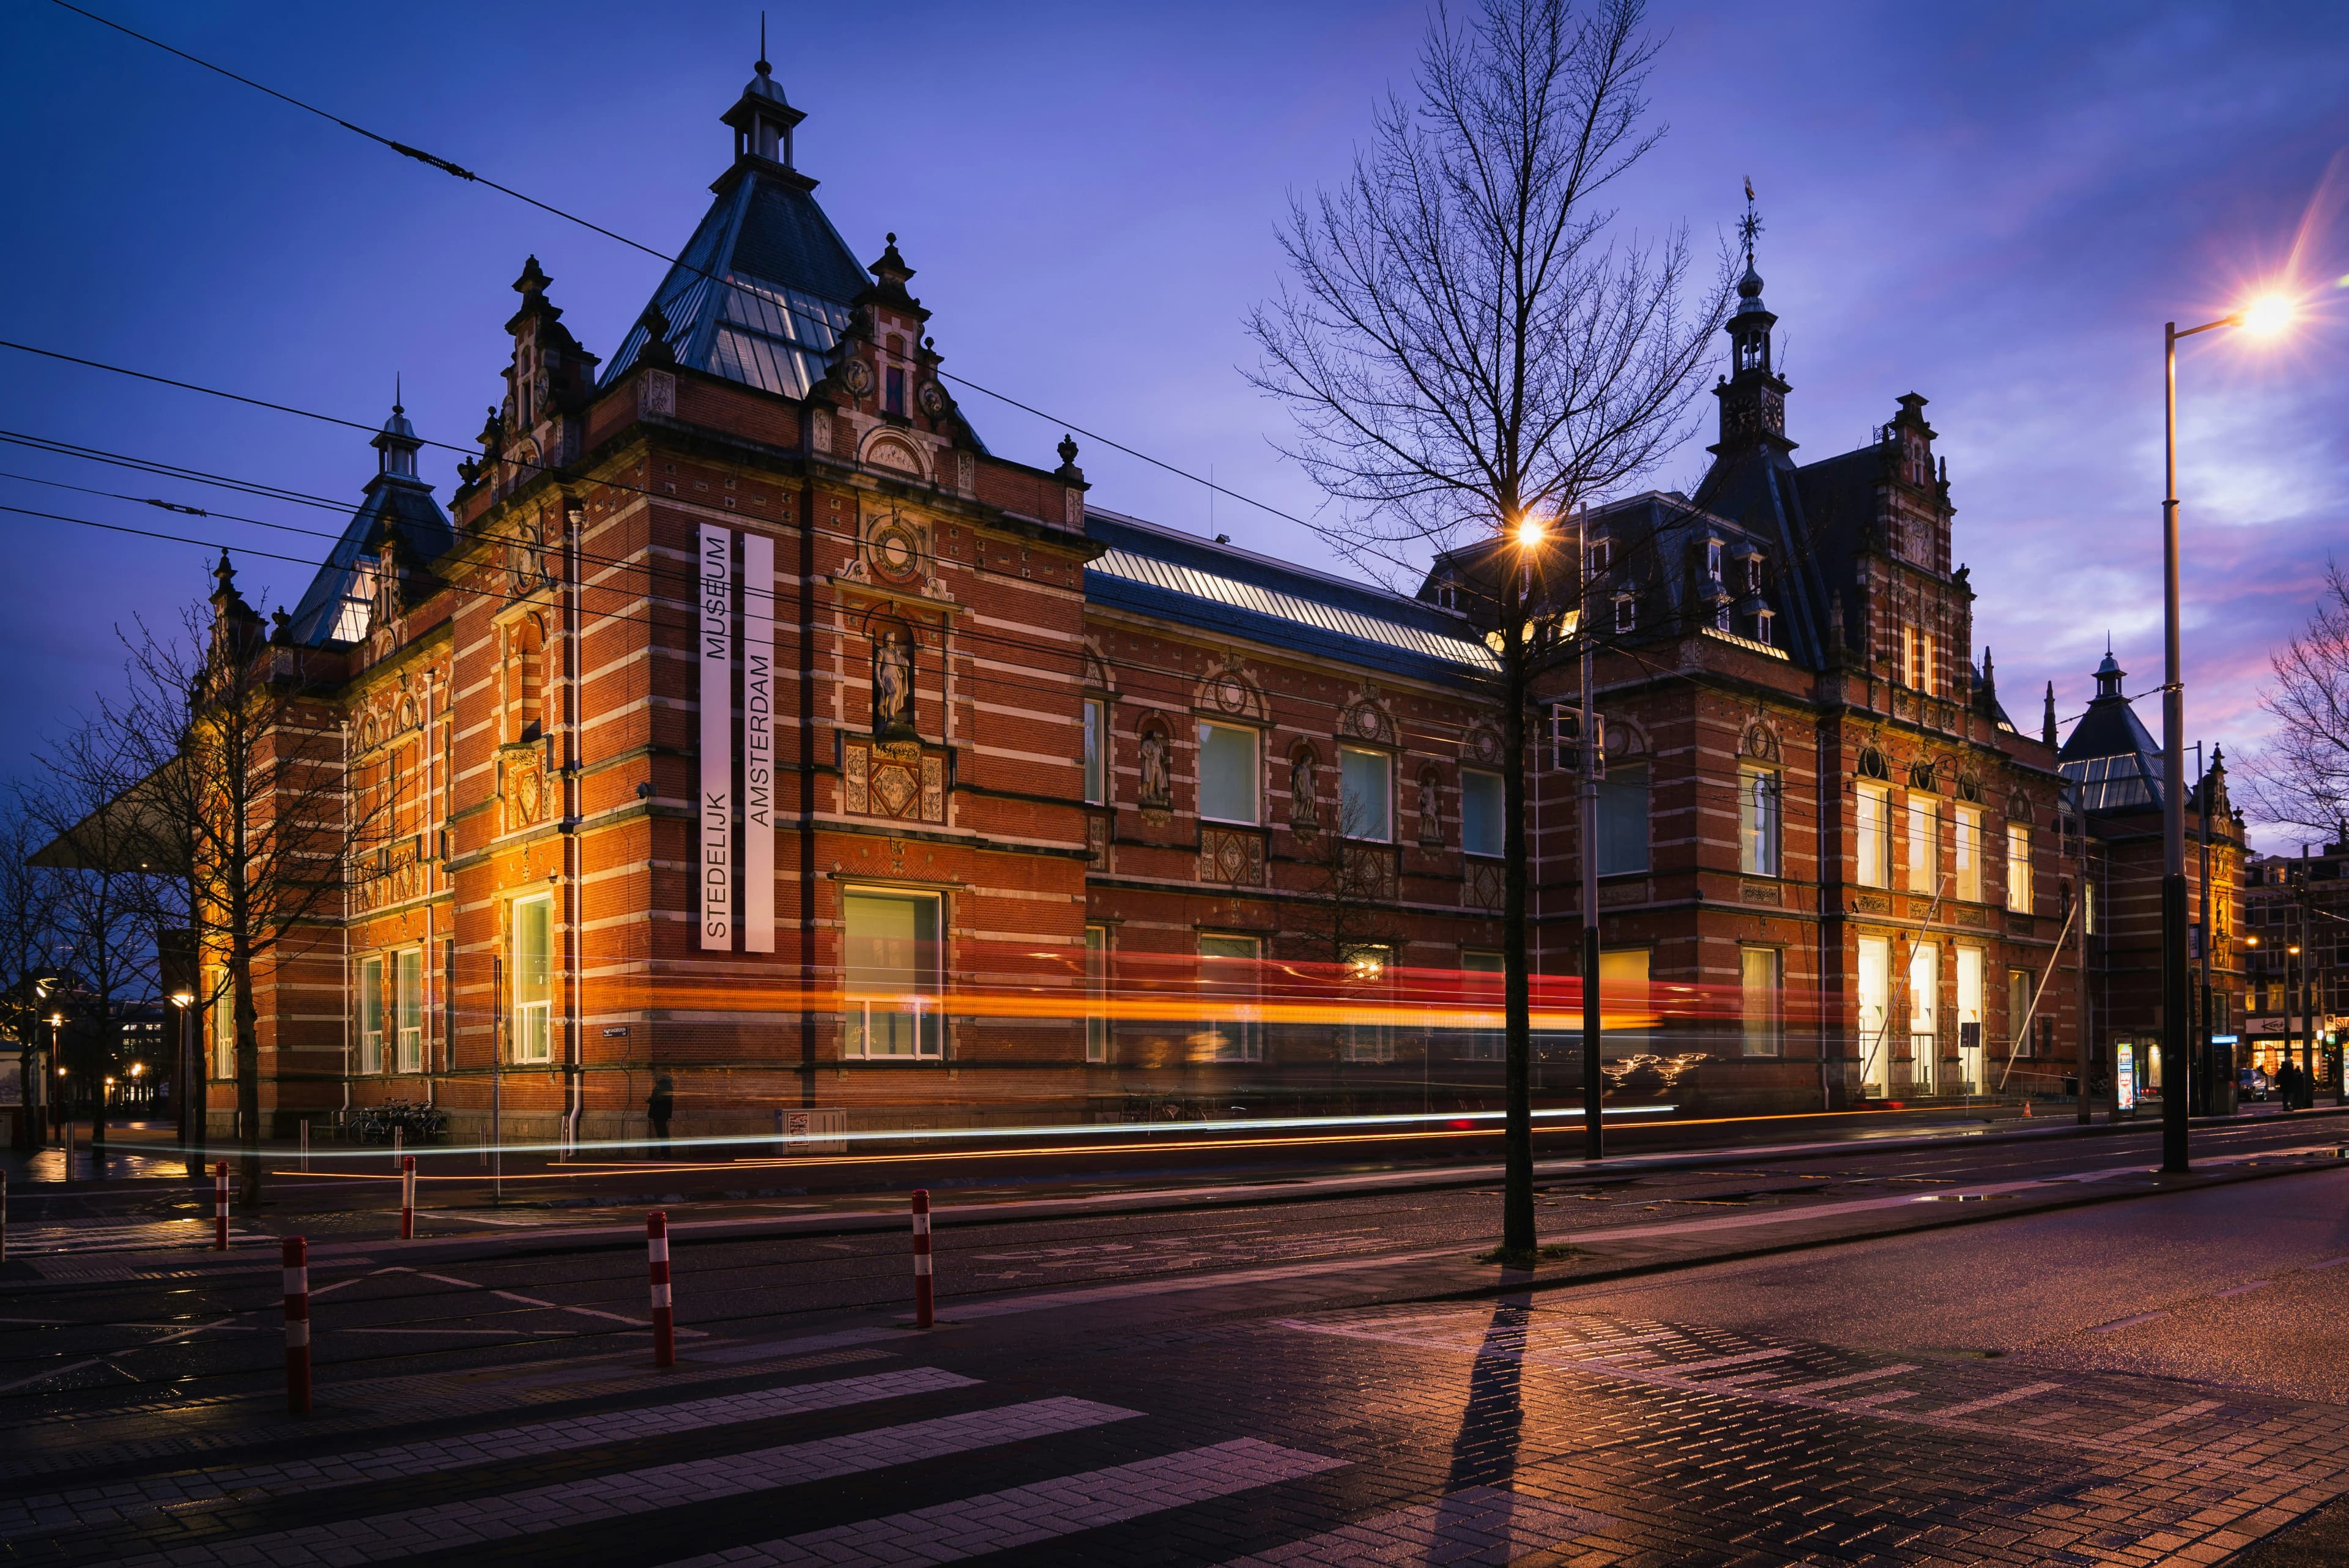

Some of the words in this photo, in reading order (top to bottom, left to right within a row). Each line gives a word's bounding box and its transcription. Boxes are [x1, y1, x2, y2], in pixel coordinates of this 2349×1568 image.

[706, 537, 725, 660] MUSEUM
[750, 655, 769, 827] AMSTERDAM
[707, 792, 726, 938] STEDELIJK
